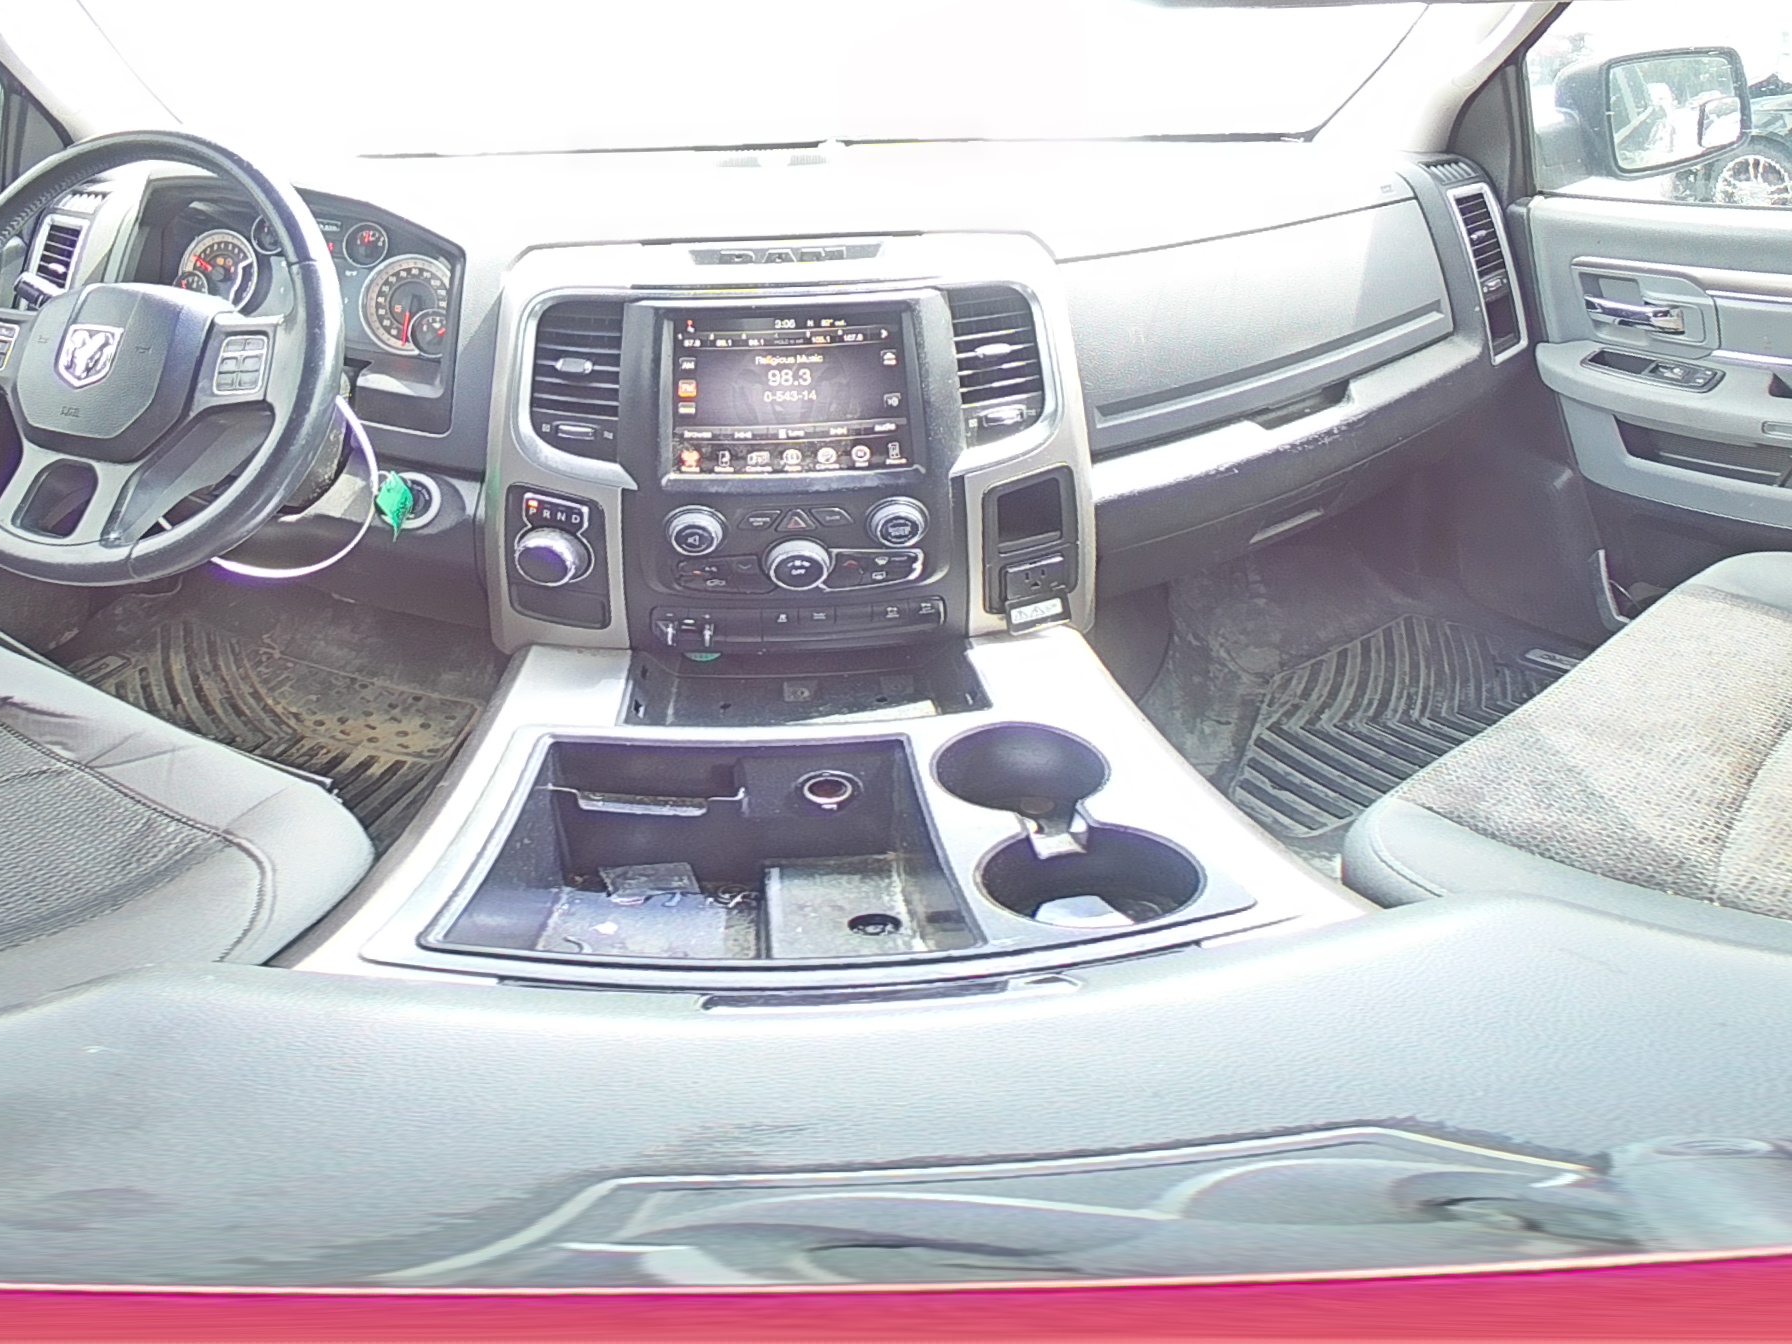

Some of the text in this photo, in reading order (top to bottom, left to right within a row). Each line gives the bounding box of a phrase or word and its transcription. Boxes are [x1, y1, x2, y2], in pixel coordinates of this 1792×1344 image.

[755, 353, 823, 366] Religious Music
[768, 368, 812, 387] 98.3
[763, 389, 817, 403] 0-543-14
[529, 507, 536, 515] P
[543, 509, 551, 519] R
[557, 511, 566, 521] N
[571, 514, 580, 523] D
